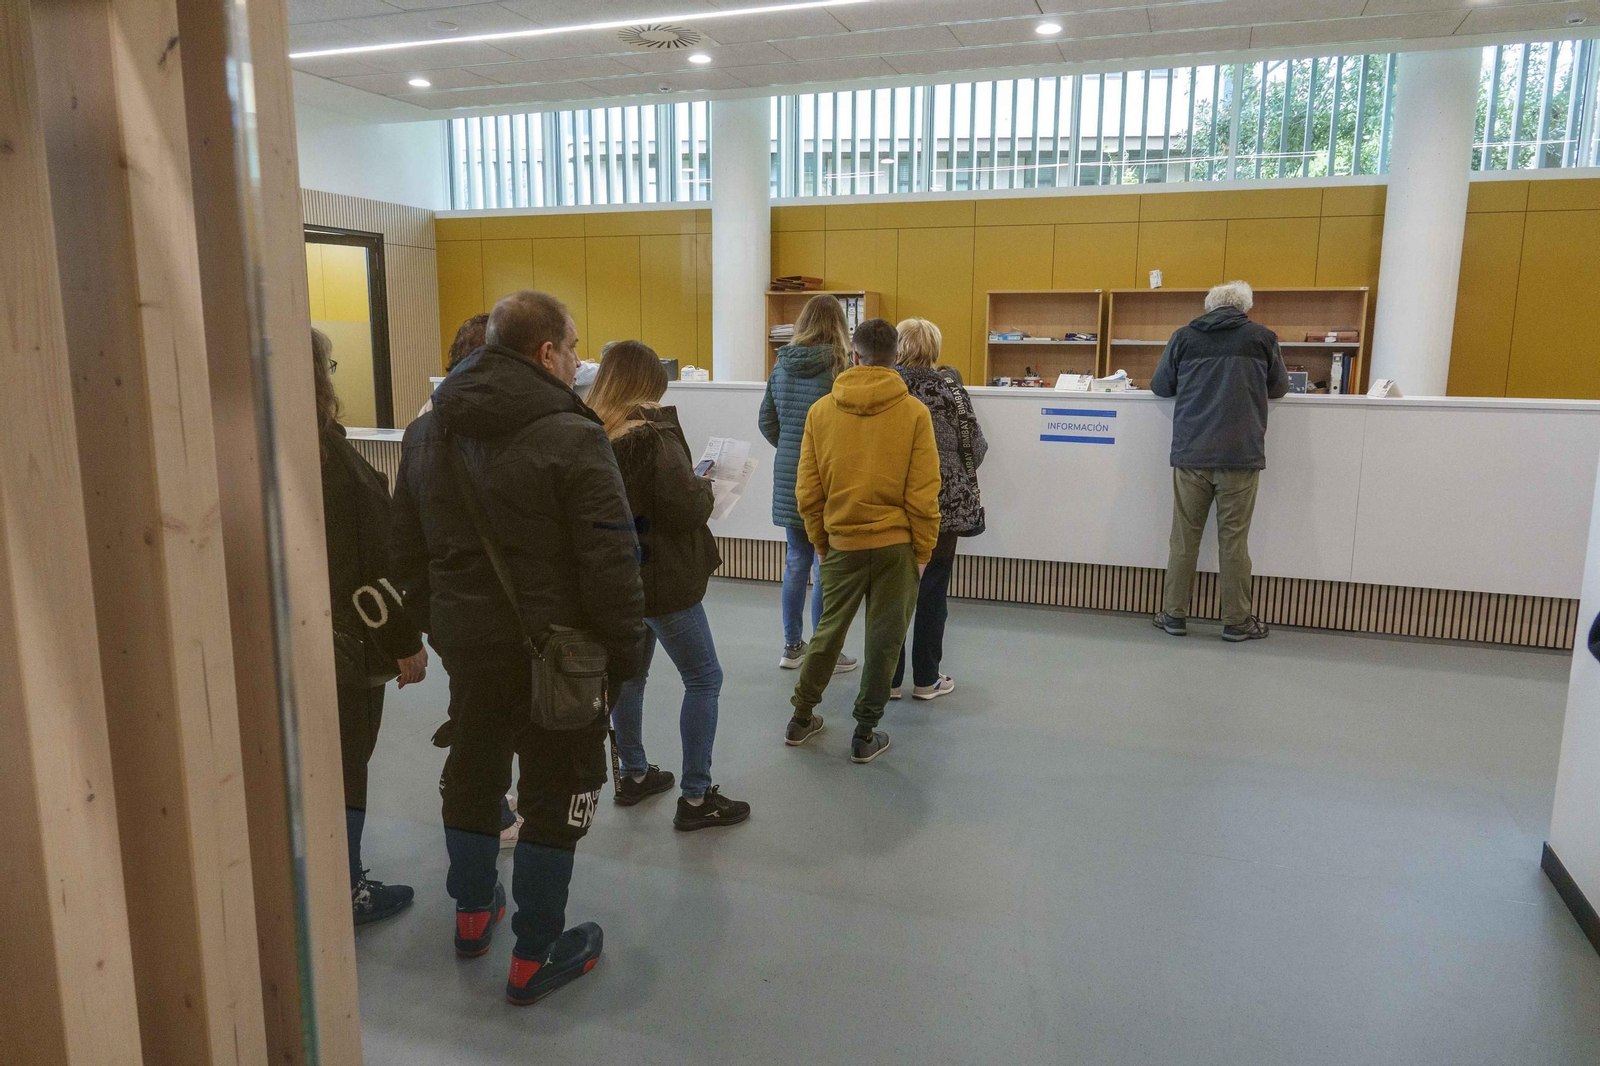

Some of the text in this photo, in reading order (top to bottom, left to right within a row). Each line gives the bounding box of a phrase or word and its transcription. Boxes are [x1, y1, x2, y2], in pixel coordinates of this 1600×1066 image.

[950, 386, 966, 415] BIMBAY
[960, 420, 971, 448] BIMBAY
[1047, 422, 1109, 432] INFORMACIÓN
